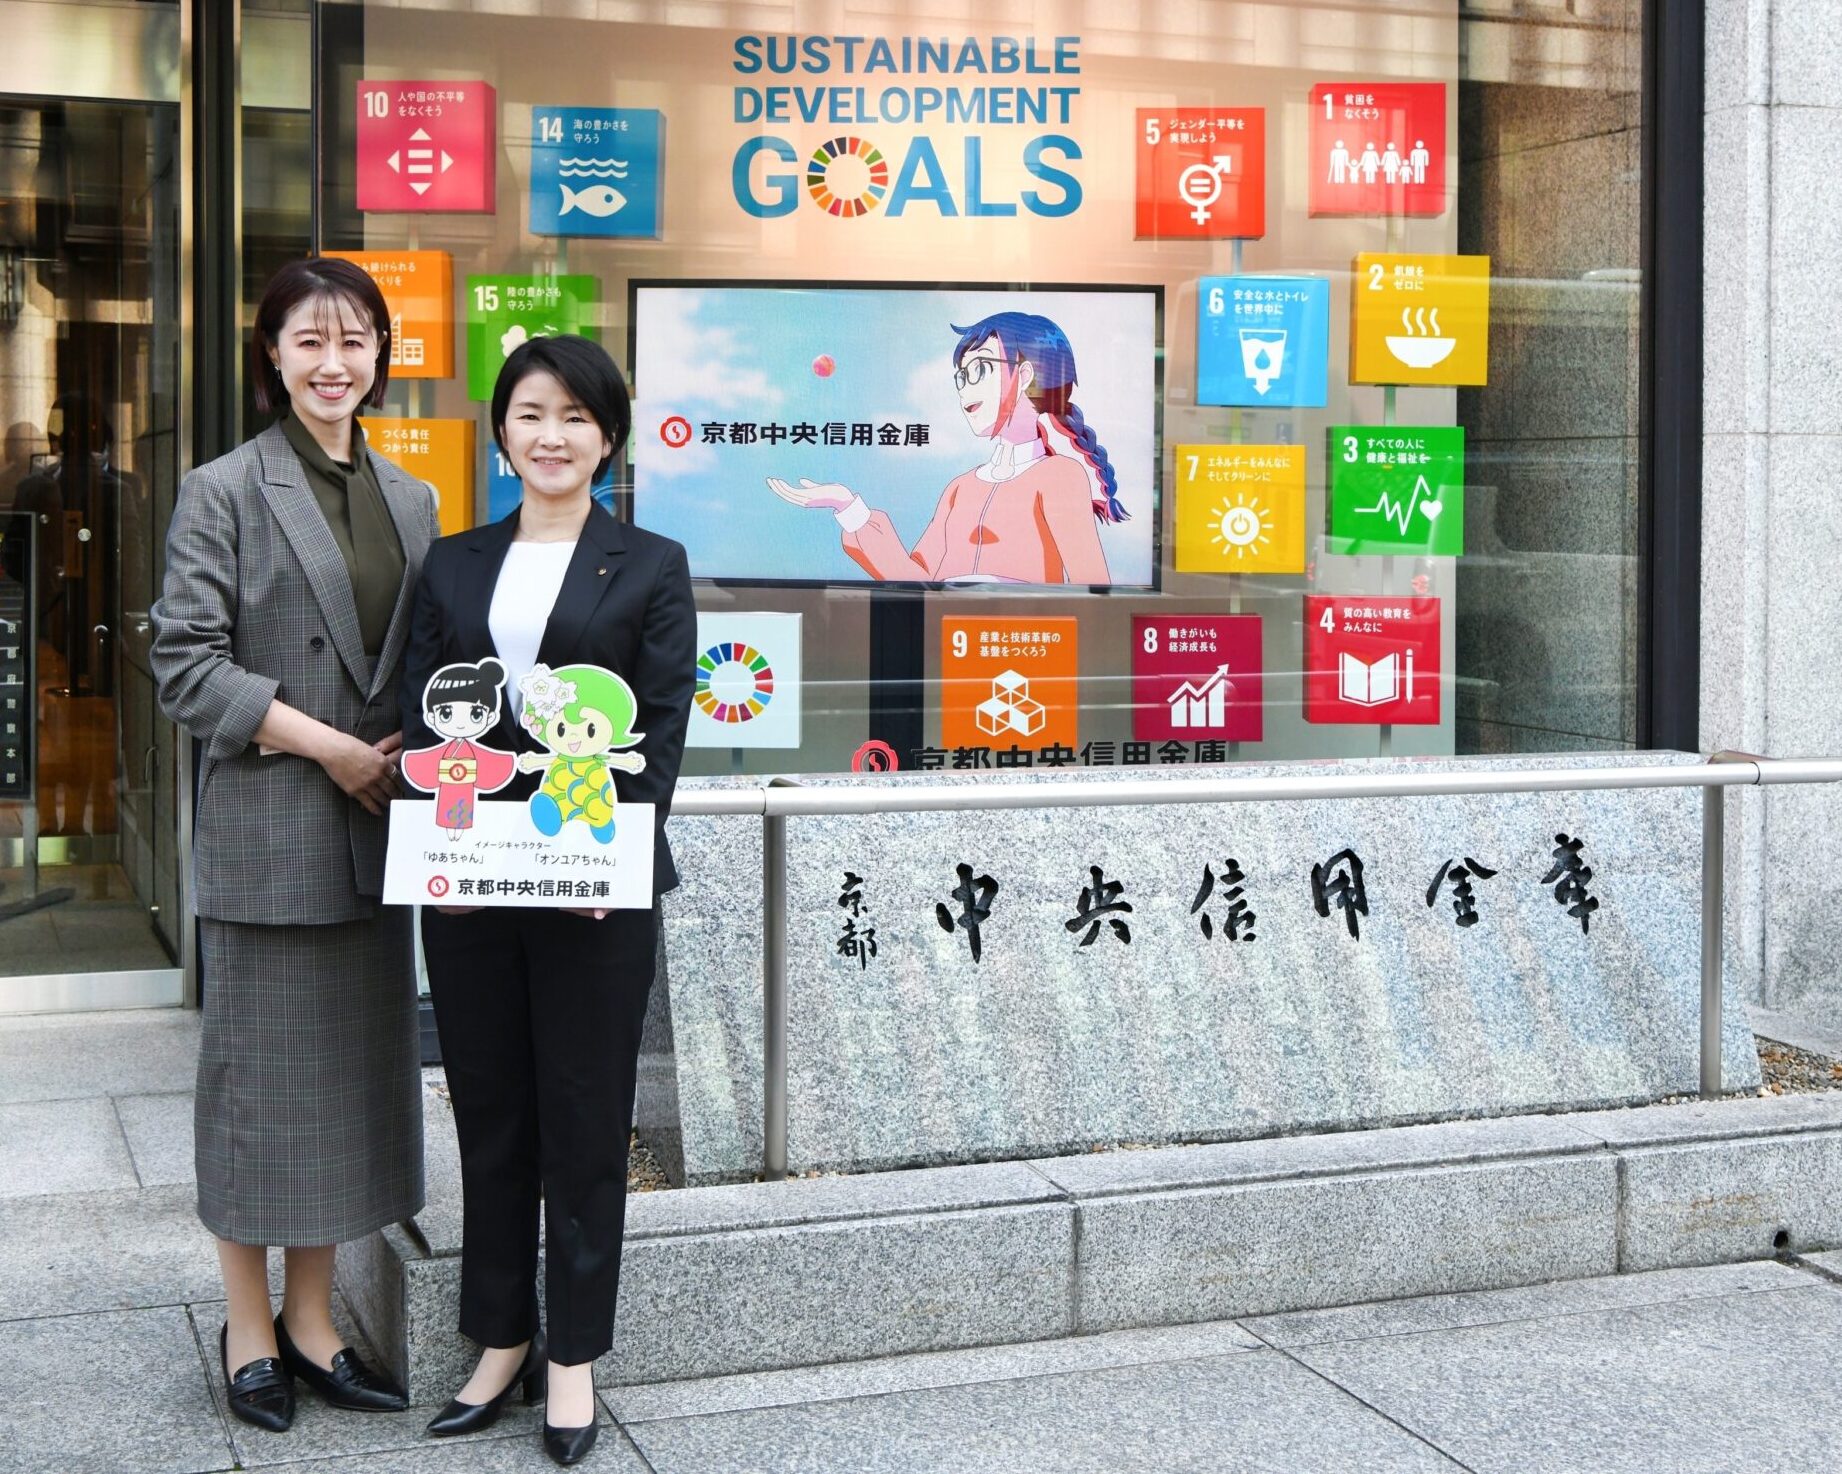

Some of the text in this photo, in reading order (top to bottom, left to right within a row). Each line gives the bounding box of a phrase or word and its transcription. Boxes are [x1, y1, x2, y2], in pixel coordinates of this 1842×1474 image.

[732, 35, 1081, 75] SUSTAINABLE
[397, 91, 465, 104] 人や国の不平等
[1344, 93, 1375, 106] 貧困を
[363, 91, 389, 118] 10
[397, 105, 444, 117] をなくそう
[733, 86, 1081, 125] DEVELOPMENT
[1322, 93, 1334, 120] 1
[1344, 108, 1380, 120] なくそう
[538, 117, 564, 144] 14
[573, 119, 630, 131] 海の豊かさを
[1168, 118, 1246, 131] ジェンダー平等を
[1145, 118, 1161, 145] 5
[1168, 132, 1217, 144] 実現しよう
[573, 133, 600, 145] 守ろう
[731, 134, 1084, 218] GOALS
[1368, 263, 1384, 290] 2
[1393, 279, 1425, 291] ゼロに
[473, 285, 499, 312] 15
[506, 286, 562, 298] 陸の豊かさも
[1233, 289, 1309, 302] 安全な水とトイレ
[507, 300, 534, 311] 守ろう
[1209, 287, 1225, 314] 6
[1234, 303, 1285, 316] を世界中に
[381, 428, 430, 441] つくる責任
[700, 421, 931, 448] 京都中央信用金庫
[381, 443, 430, 454] つかう責任
[1343, 435, 1359, 463] 3
[1366, 438, 1425, 450] すべての人に
[1207, 456, 1291, 469] エネルギーをみんなに
[1366, 452, 1428, 464] 健康と福祉を
[1185, 455, 1200, 482] 7
[1207, 471, 1272, 482] そしてクリーンに
[1319, 607, 1336, 633] 4
[1343, 607, 1412, 620] 質の高い教育を
[1168, 628, 1218, 640] 働きがいも
[1343, 622, 1383, 633] みんなに
[979, 631, 1062, 644] 産業と技術革新の
[1143, 627, 1159, 654] 8
[952, 630, 969, 659] 9
[1168, 641, 1218, 654] 経済成長も
[979, 645, 1048, 658] 基盤をつくろう
[474, 840, 552, 851] イメージキャラクター
[422, 851, 485, 865] 「ゆあちゃん」
[534, 852, 617, 868] 「オンユアちゃん」
[457, 878, 611, 899] 京都中央信用金庫
